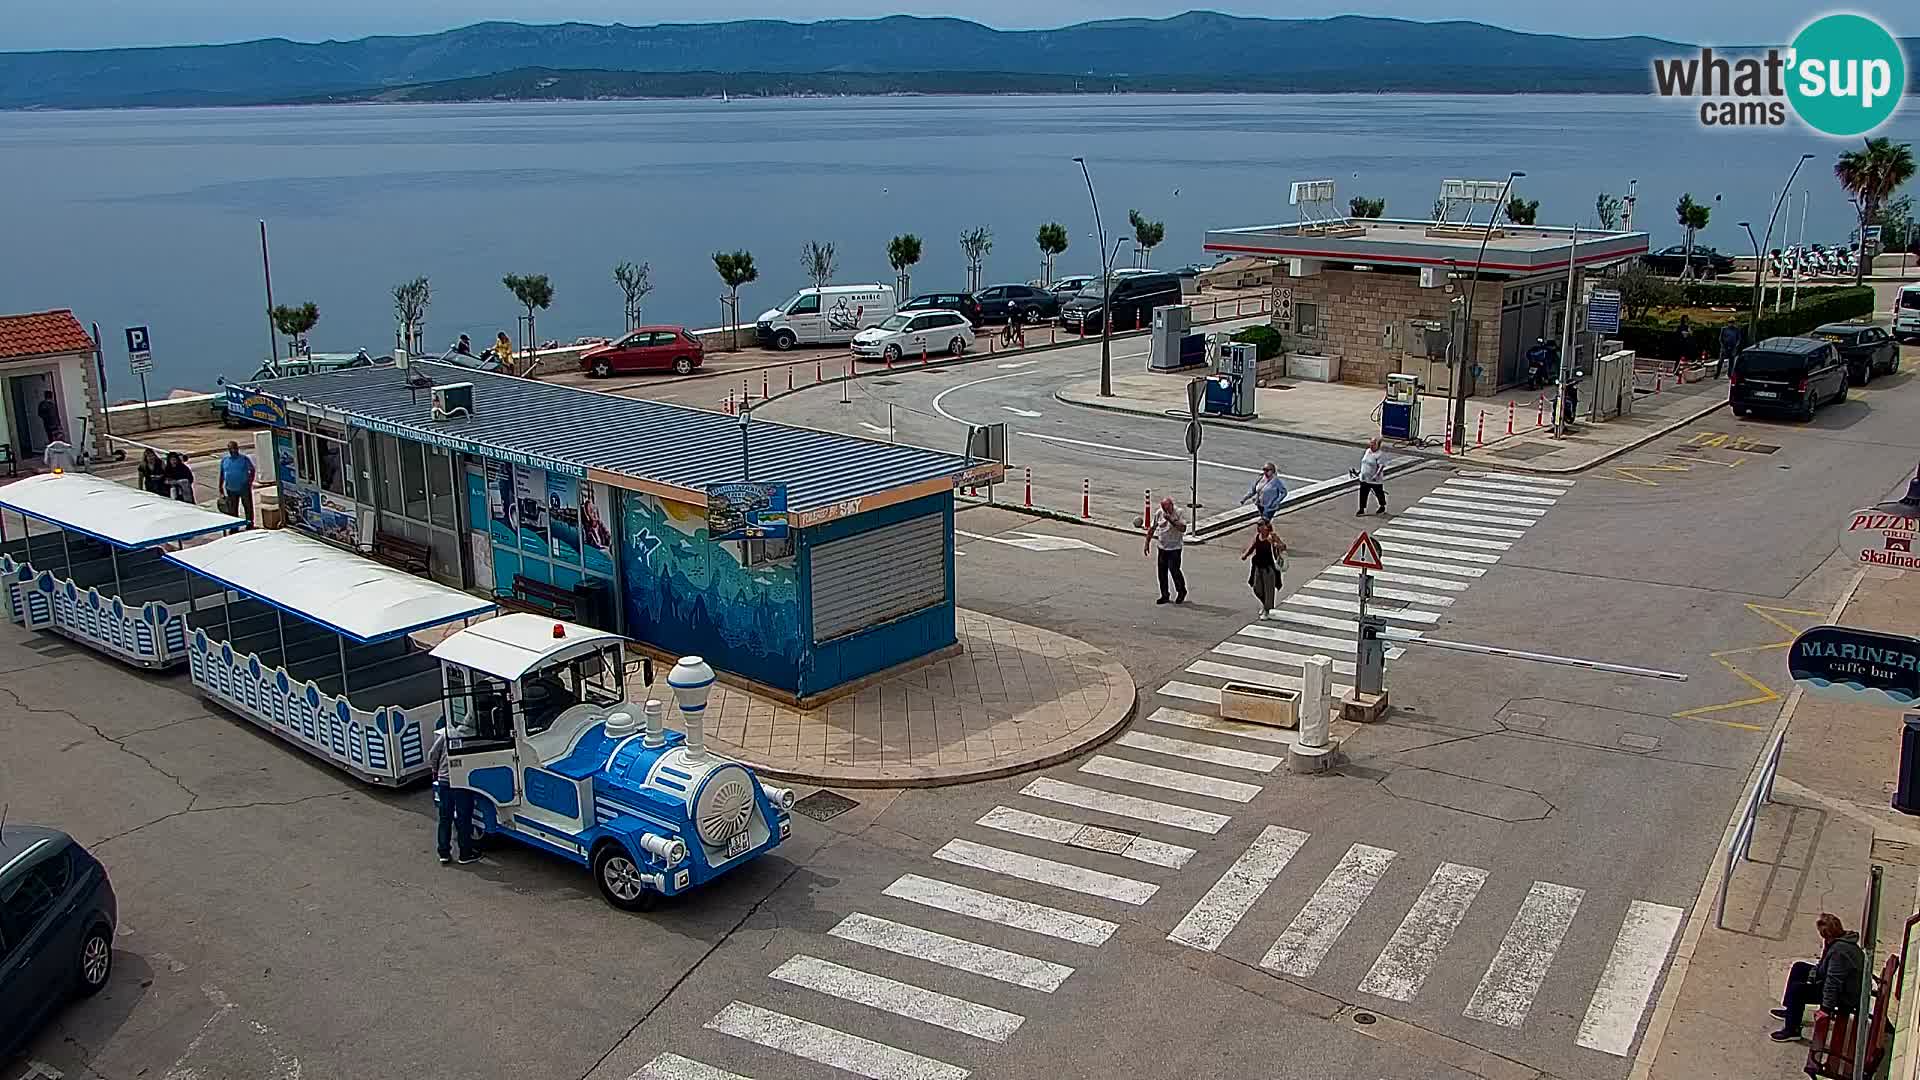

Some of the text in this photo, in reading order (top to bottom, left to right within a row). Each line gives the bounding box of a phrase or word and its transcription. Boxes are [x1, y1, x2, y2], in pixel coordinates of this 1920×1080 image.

[437, 436, 469, 452] POSTAJA
[479, 445, 494, 457] BUS
[495, 449, 527, 465] STATION
[528, 456, 555, 471] TICKET
[556, 463, 583, 477] OFFICE
[1847, 512, 1920, 533] PIZZE
[1882, 529, 1918, 540] GRILL
[1801, 641, 1920, 673] MARINER
[1829, 662, 1897, 680] caffe bar
